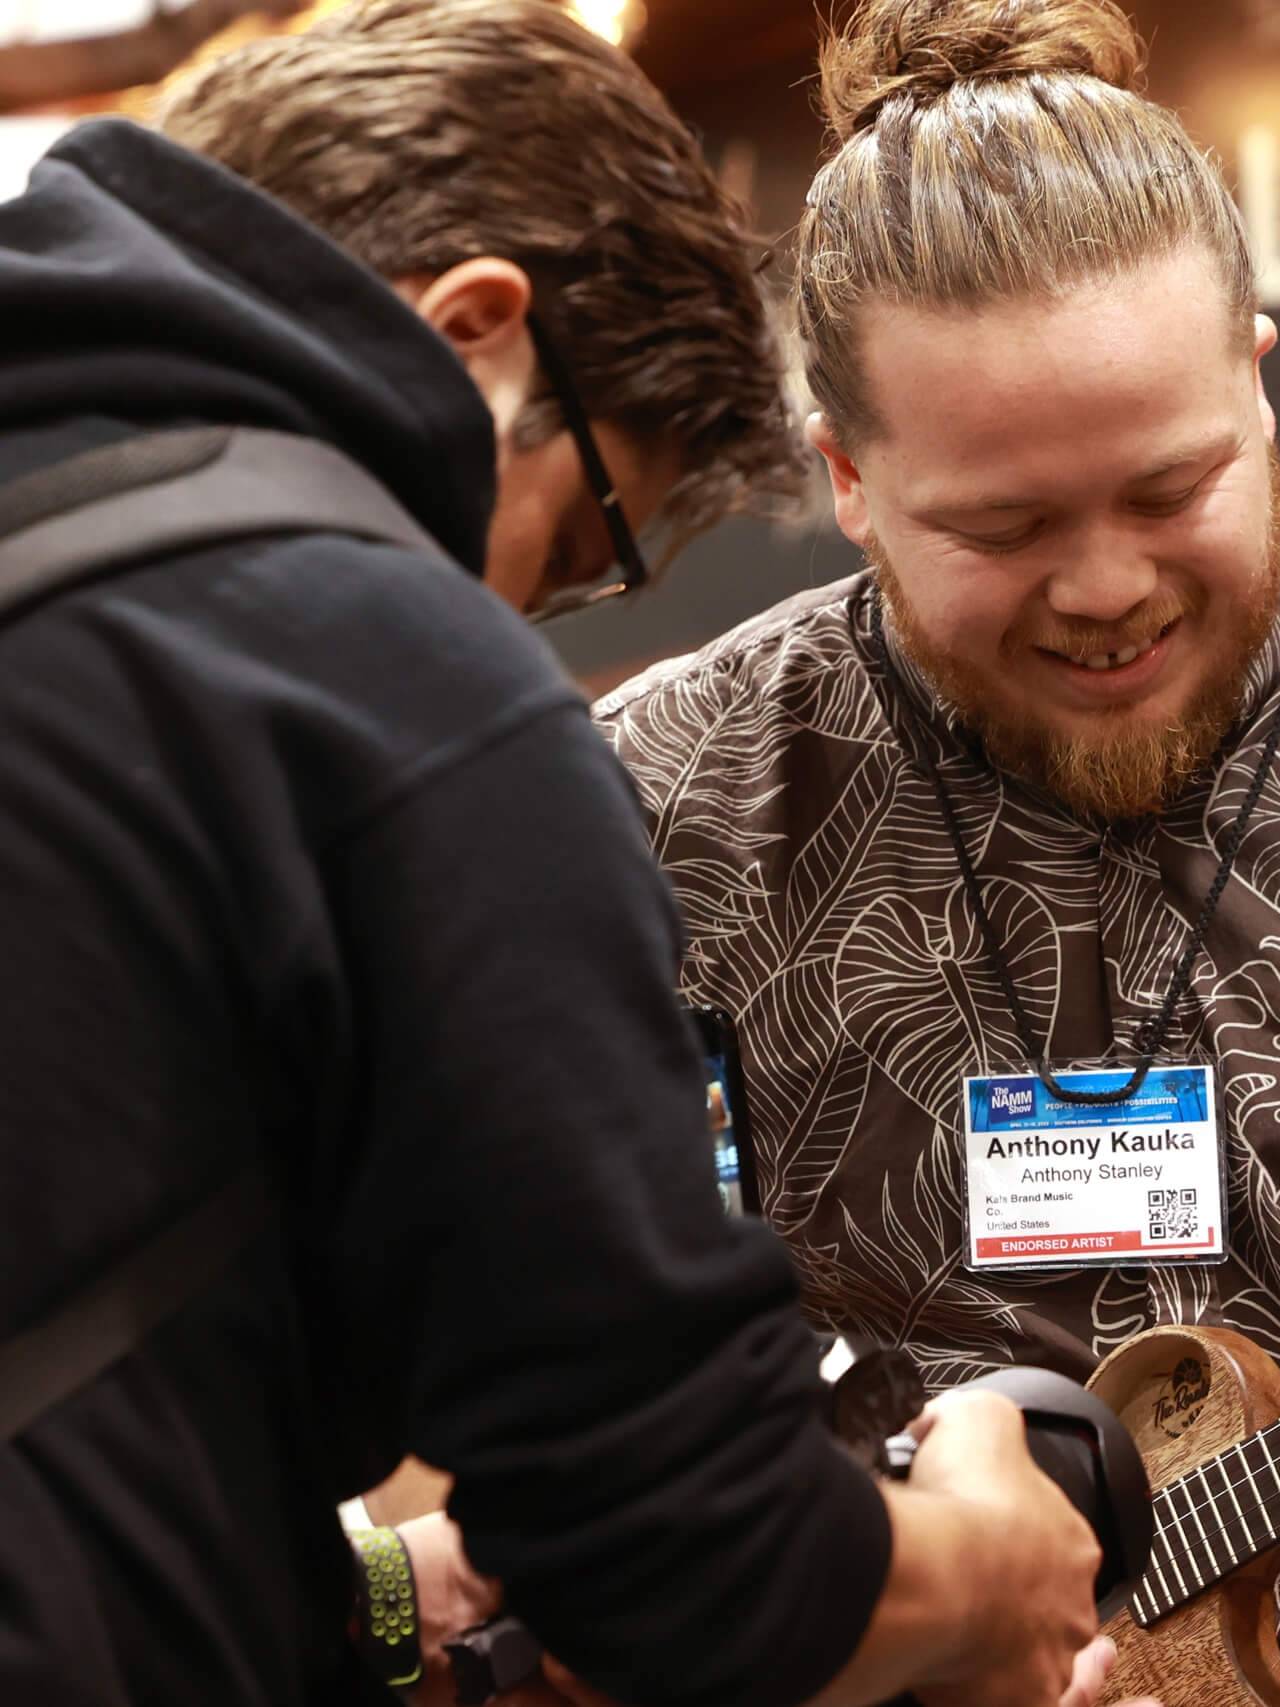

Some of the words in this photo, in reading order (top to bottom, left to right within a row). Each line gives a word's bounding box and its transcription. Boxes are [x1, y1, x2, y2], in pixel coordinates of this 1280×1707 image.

[994, 1087, 1009, 1097] The
[991, 1090, 1032, 1109] NAMM
[1008, 1104, 1032, 1115] Show
[986, 1135, 1101, 1160] Anthony
[1111, 1129, 1195, 1153] Kauka
[1021, 1167, 1092, 1184] Anthony
[1098, 1162, 1163, 1180] Stanley
[1010, 1193, 1041, 1203] Brand
[1043, 1192, 1073, 1201] Music
[987, 1220, 1018, 1231] United
[1020, 1219, 1050, 1229] States
[1001, 1237, 1070, 1252] ENDORSED
[1071, 1235, 1114, 1250] ARTIST
